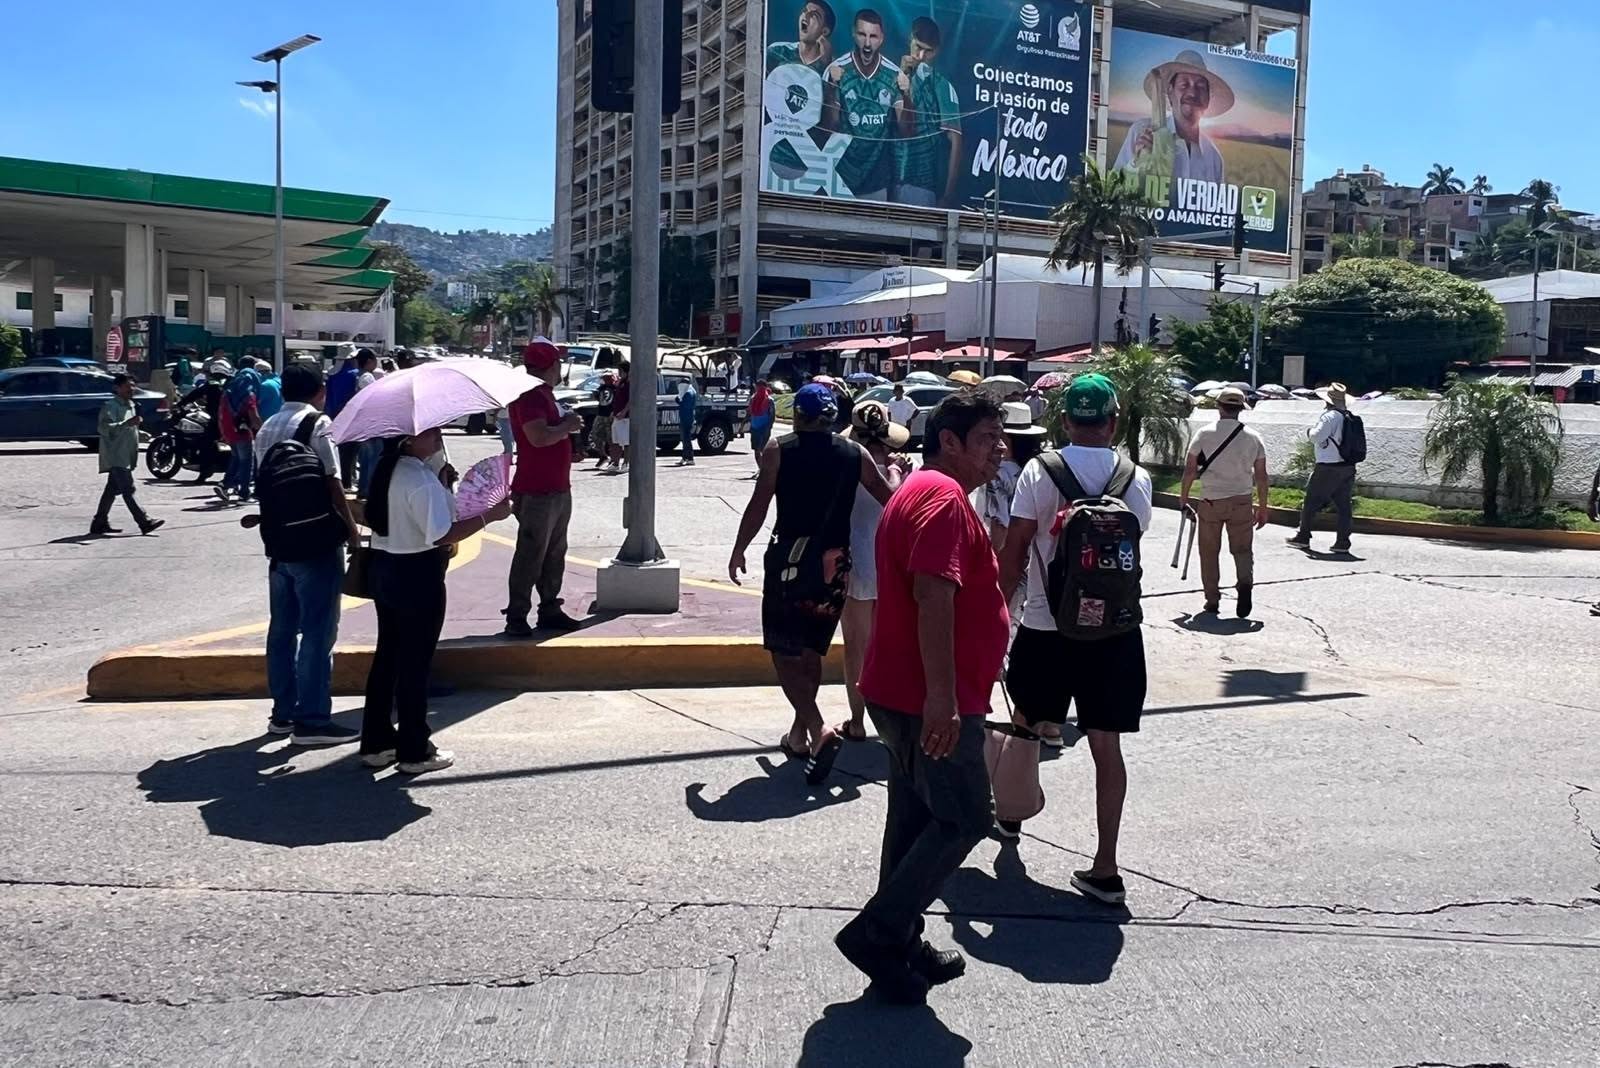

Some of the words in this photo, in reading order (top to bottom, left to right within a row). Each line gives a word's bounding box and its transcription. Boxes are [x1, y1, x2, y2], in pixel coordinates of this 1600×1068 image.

[1017, 30, 1042, 43] AT&T
[973, 62, 1073, 94] Conectamos
[975, 84, 990, 102] la
[993, 90, 1047, 111] pasión
[1050, 97, 1070, 115] de
[861, 113, 888, 126] AT&T
[1002, 107, 1048, 142] todo
[971, 138, 1068, 182] México
[1145, 175, 1171, 208] DE
[1177, 177, 1239, 215] VERDAD
[1166, 209, 1236, 229] AMANECER
[871, 318, 883, 333] LA
